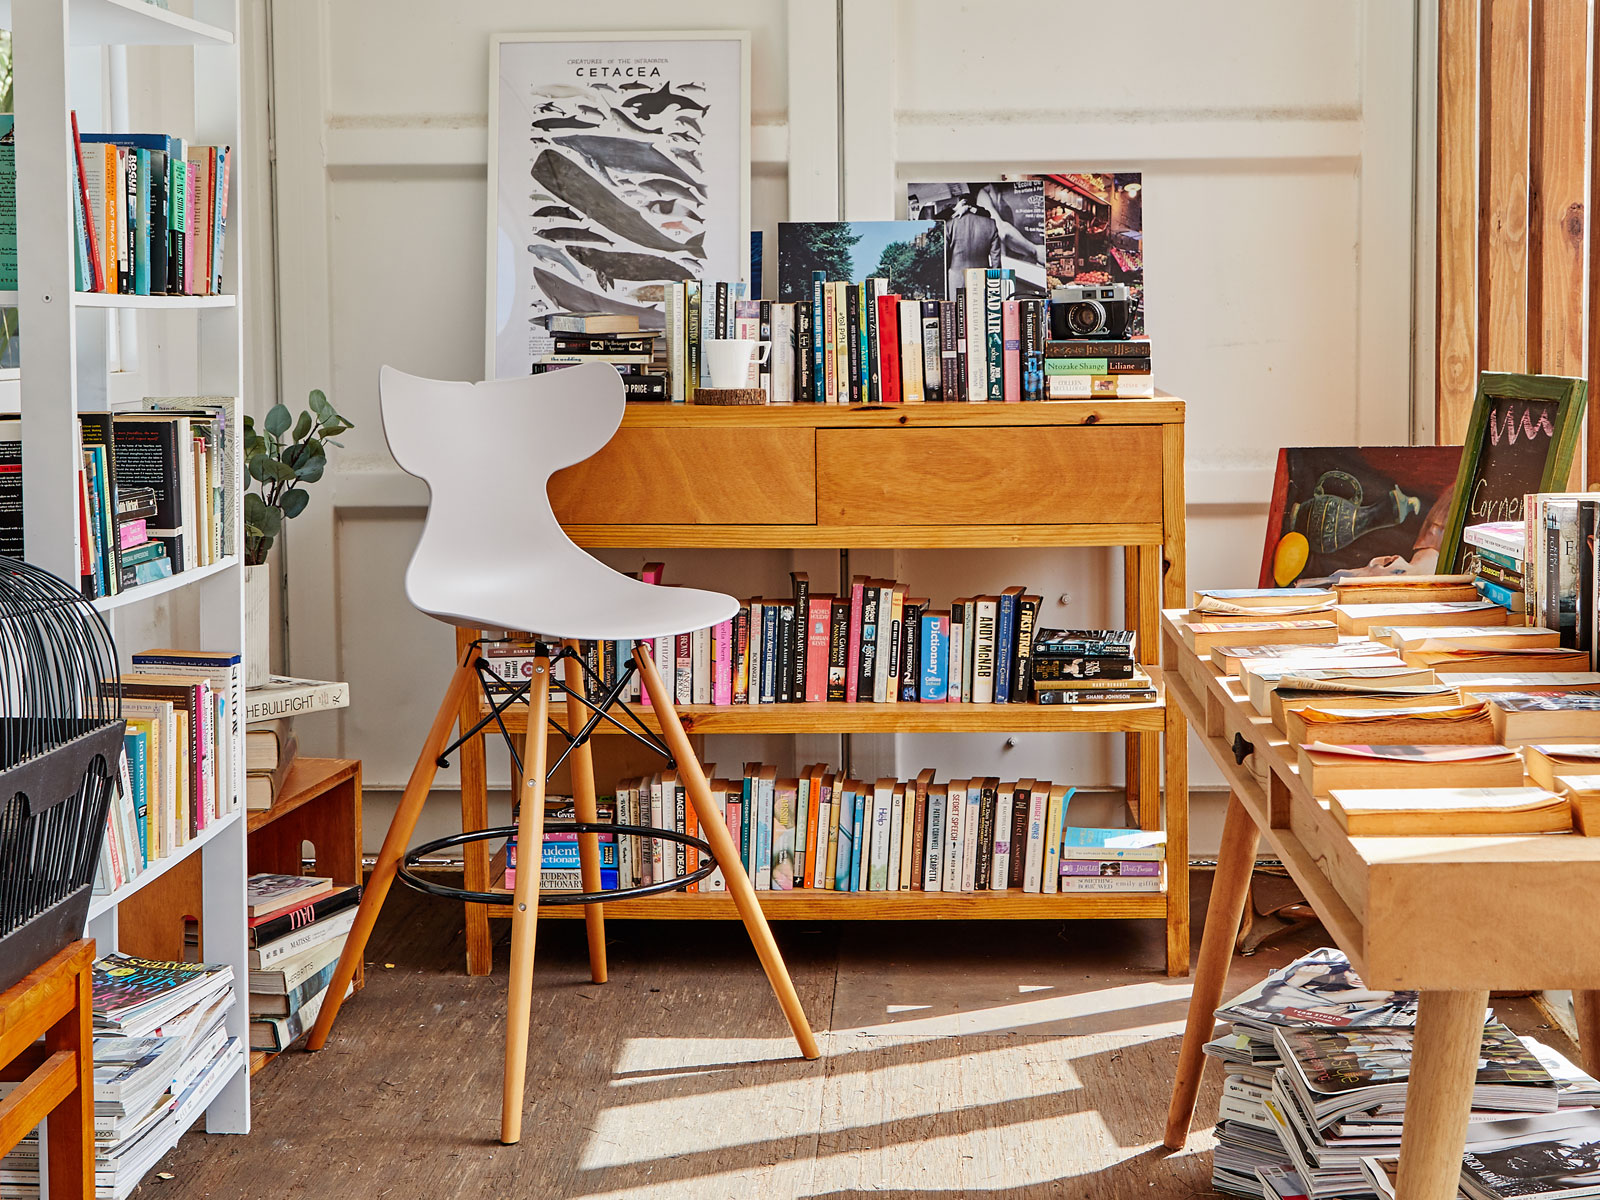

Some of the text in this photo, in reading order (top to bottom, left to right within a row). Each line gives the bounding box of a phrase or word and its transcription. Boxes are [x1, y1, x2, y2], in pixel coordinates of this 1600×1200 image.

[576, 66, 660, 77] CETACEA
[987, 278, 1002, 334] DEAD AIR
[690, 310, 698, 344] BLACKSTOCK
[926, 330, 934, 370] HORSE WHISPERER
[630, 384, 648, 393] PRICE
[1018, 610, 1032, 658] FIRST STRIKE
[927, 621, 940, 675] Dictionary
[978, 617, 993, 677] ANDY McNAB
[864, 658, 872, 677] PRINCE
[262, 694, 314, 716] BULLFIGHT
[1063, 692, 1078, 703] ICE
[780, 794, 789, 826] LARSSON
[876, 808, 887, 826] Help
[1015, 812, 1027, 836] Juliet
[1031, 822, 1040, 839] JONES
[931, 828, 940, 850] CORNWELL
[929, 854, 939, 882] SCARPETTA
[289, 905, 315, 930] DALI
[290, 934, 311, 950] MATISSE
[126, 958, 204, 971] TRAVELS
[1315, 1012, 1342, 1021] STUDIO
